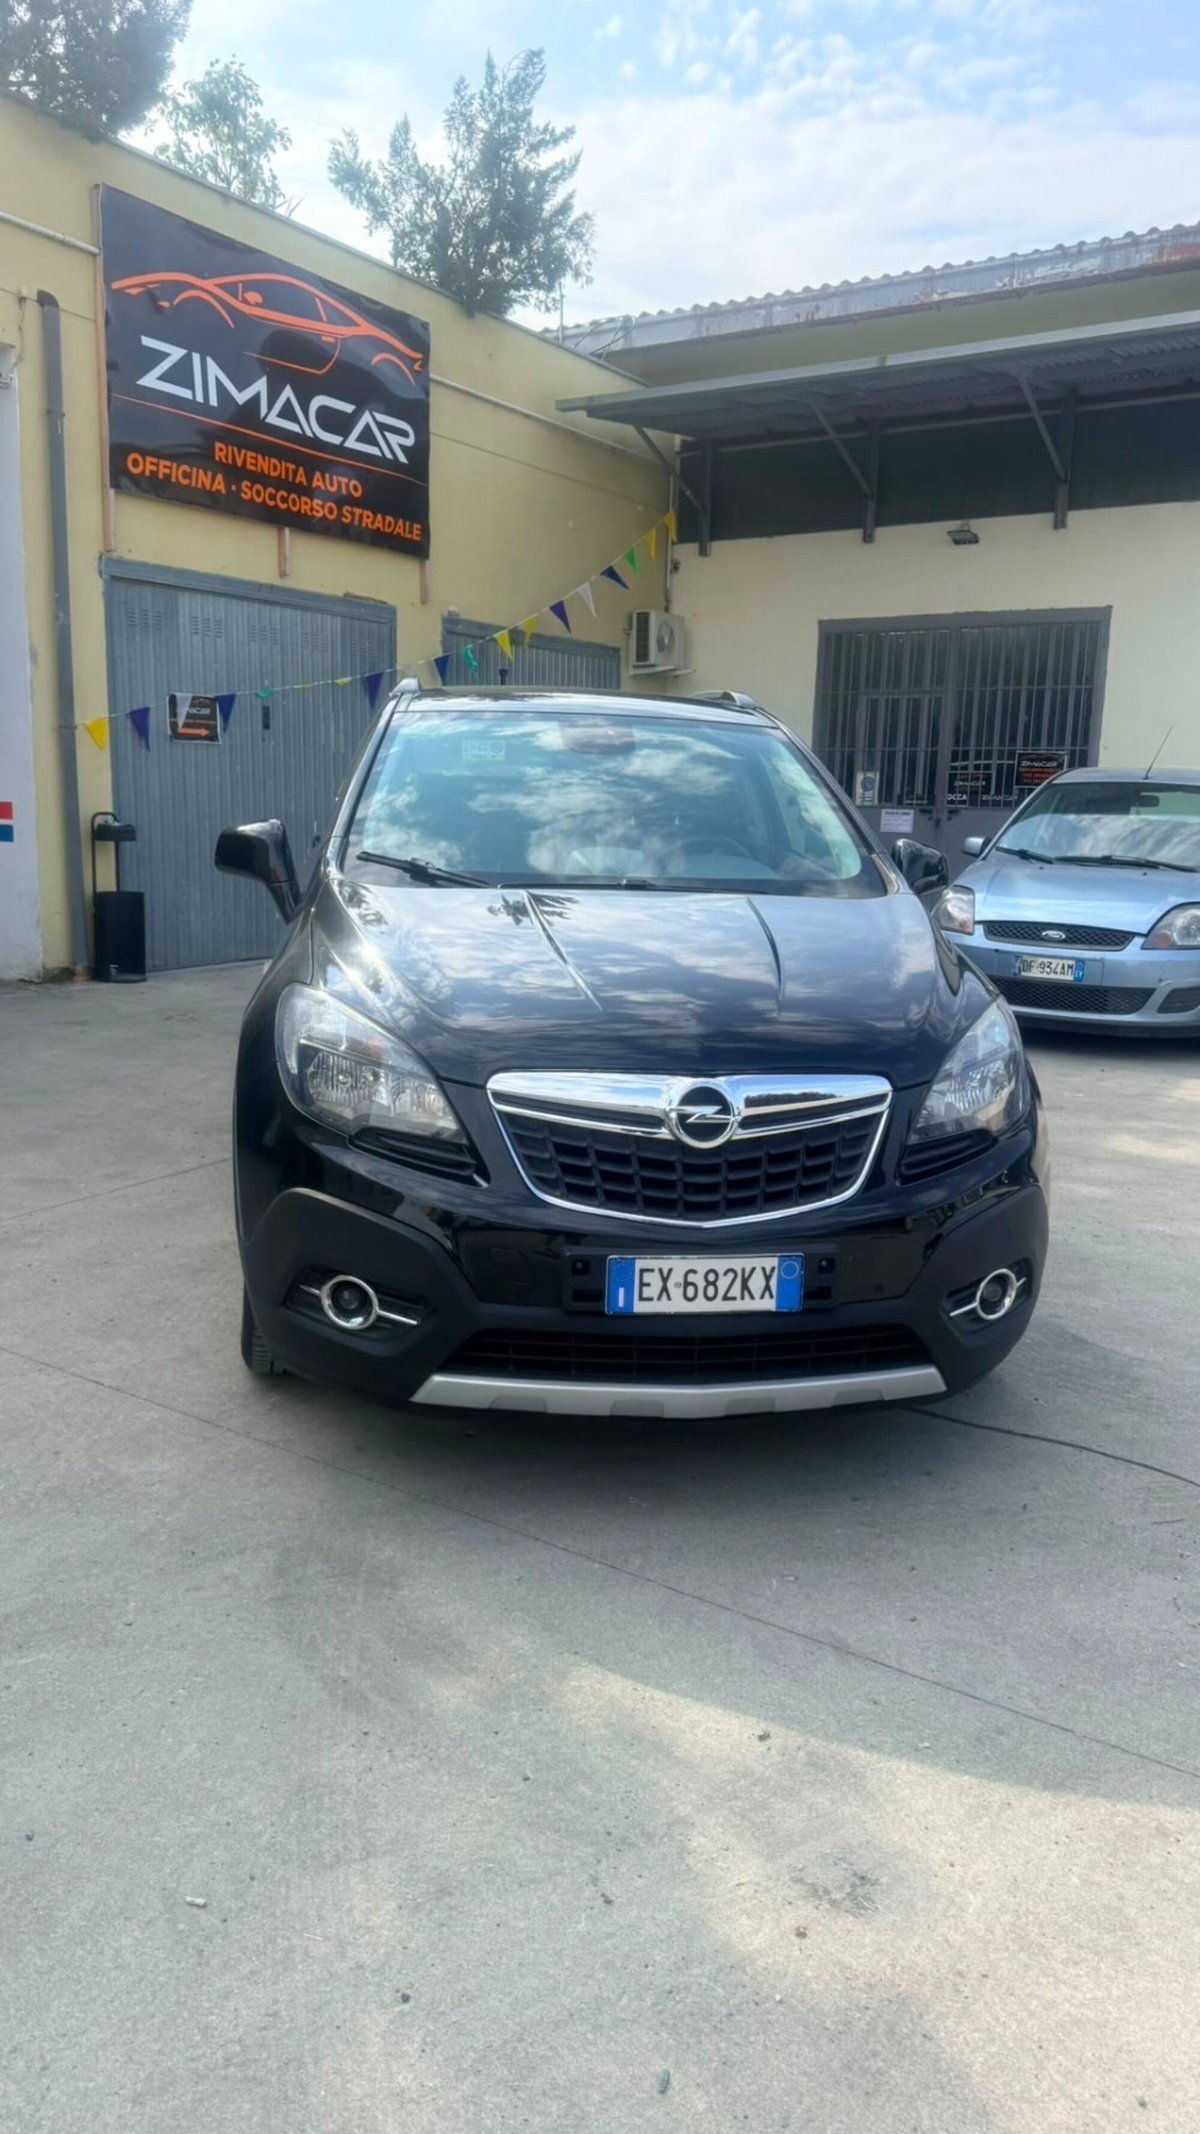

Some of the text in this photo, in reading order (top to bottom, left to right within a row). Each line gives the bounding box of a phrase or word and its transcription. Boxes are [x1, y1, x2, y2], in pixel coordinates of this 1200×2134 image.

[136, 335, 415, 465] ZIMACAR
[127, 453, 422, 542] OFFICINA SOCCORSO STRADALE
[214, 441, 363, 498] RIVENDITA AUTO
